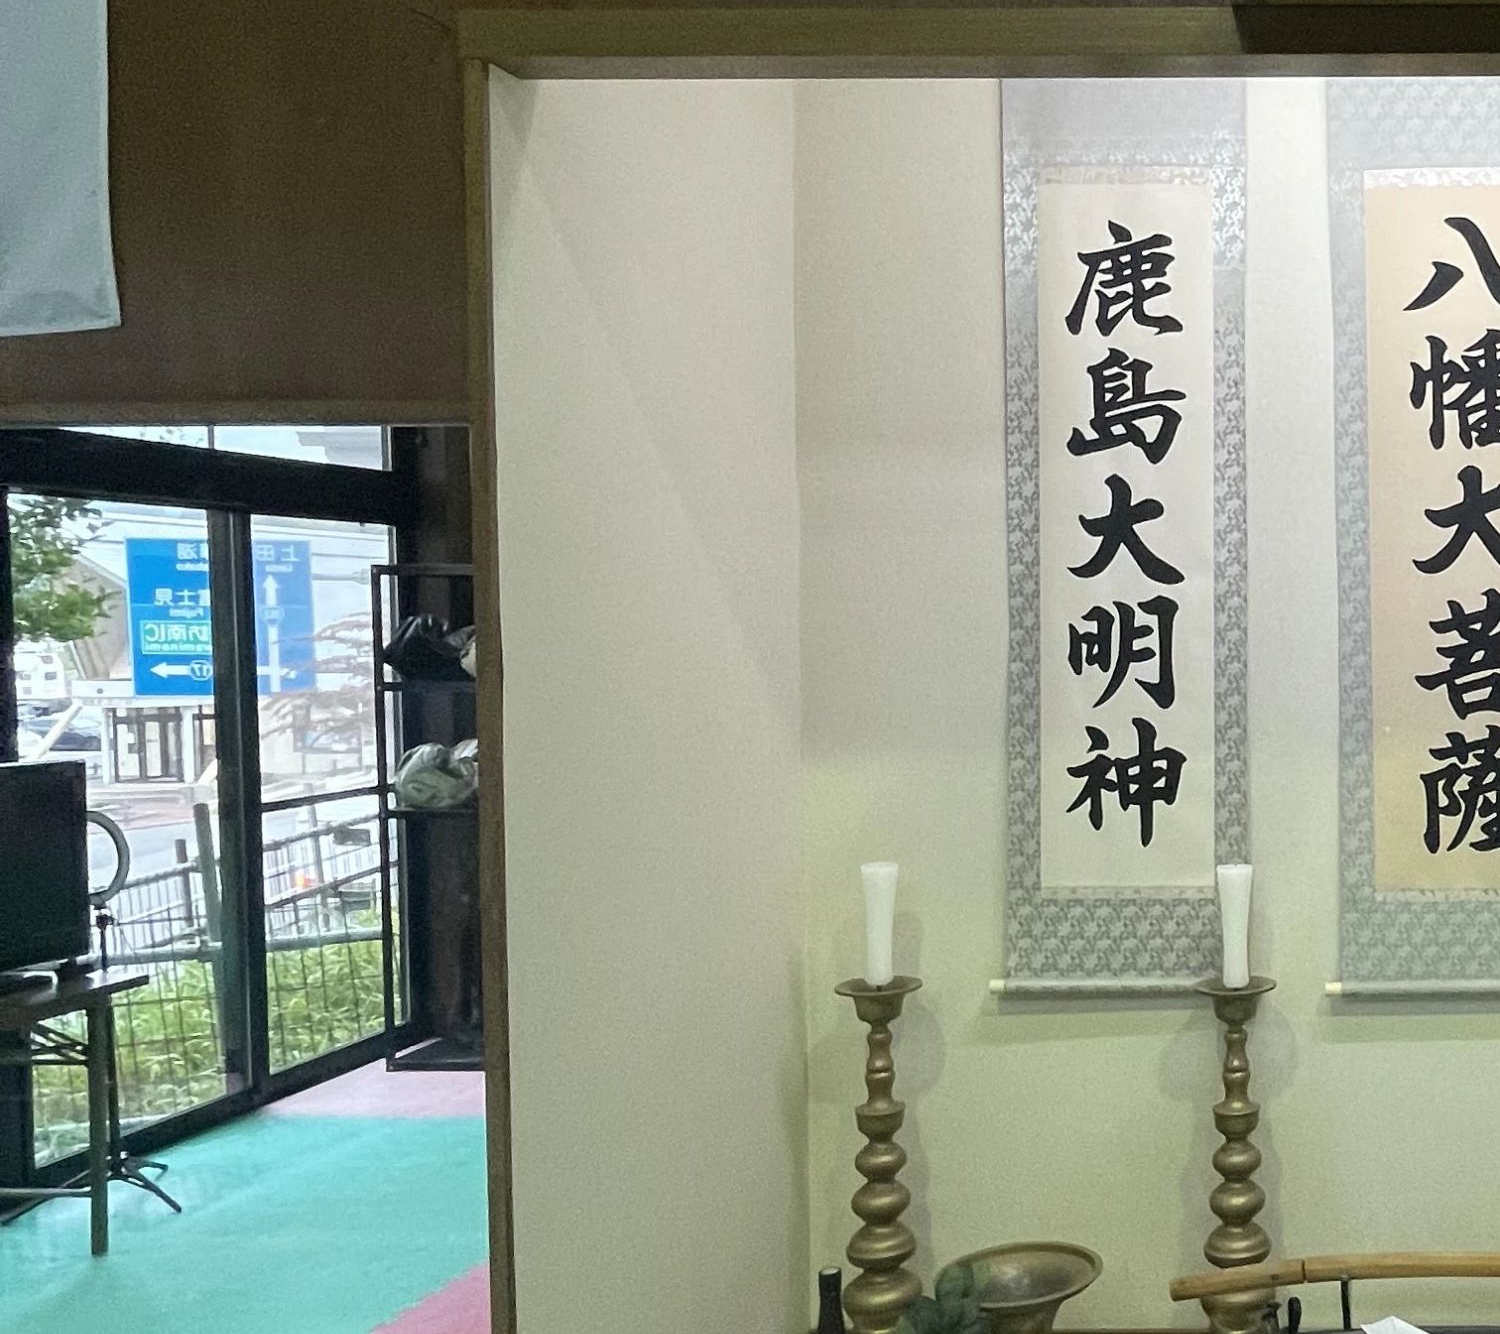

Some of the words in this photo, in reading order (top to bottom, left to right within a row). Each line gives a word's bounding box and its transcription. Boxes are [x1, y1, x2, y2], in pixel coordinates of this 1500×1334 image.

[1065, 219, 1188, 848] 鹿島大明神
